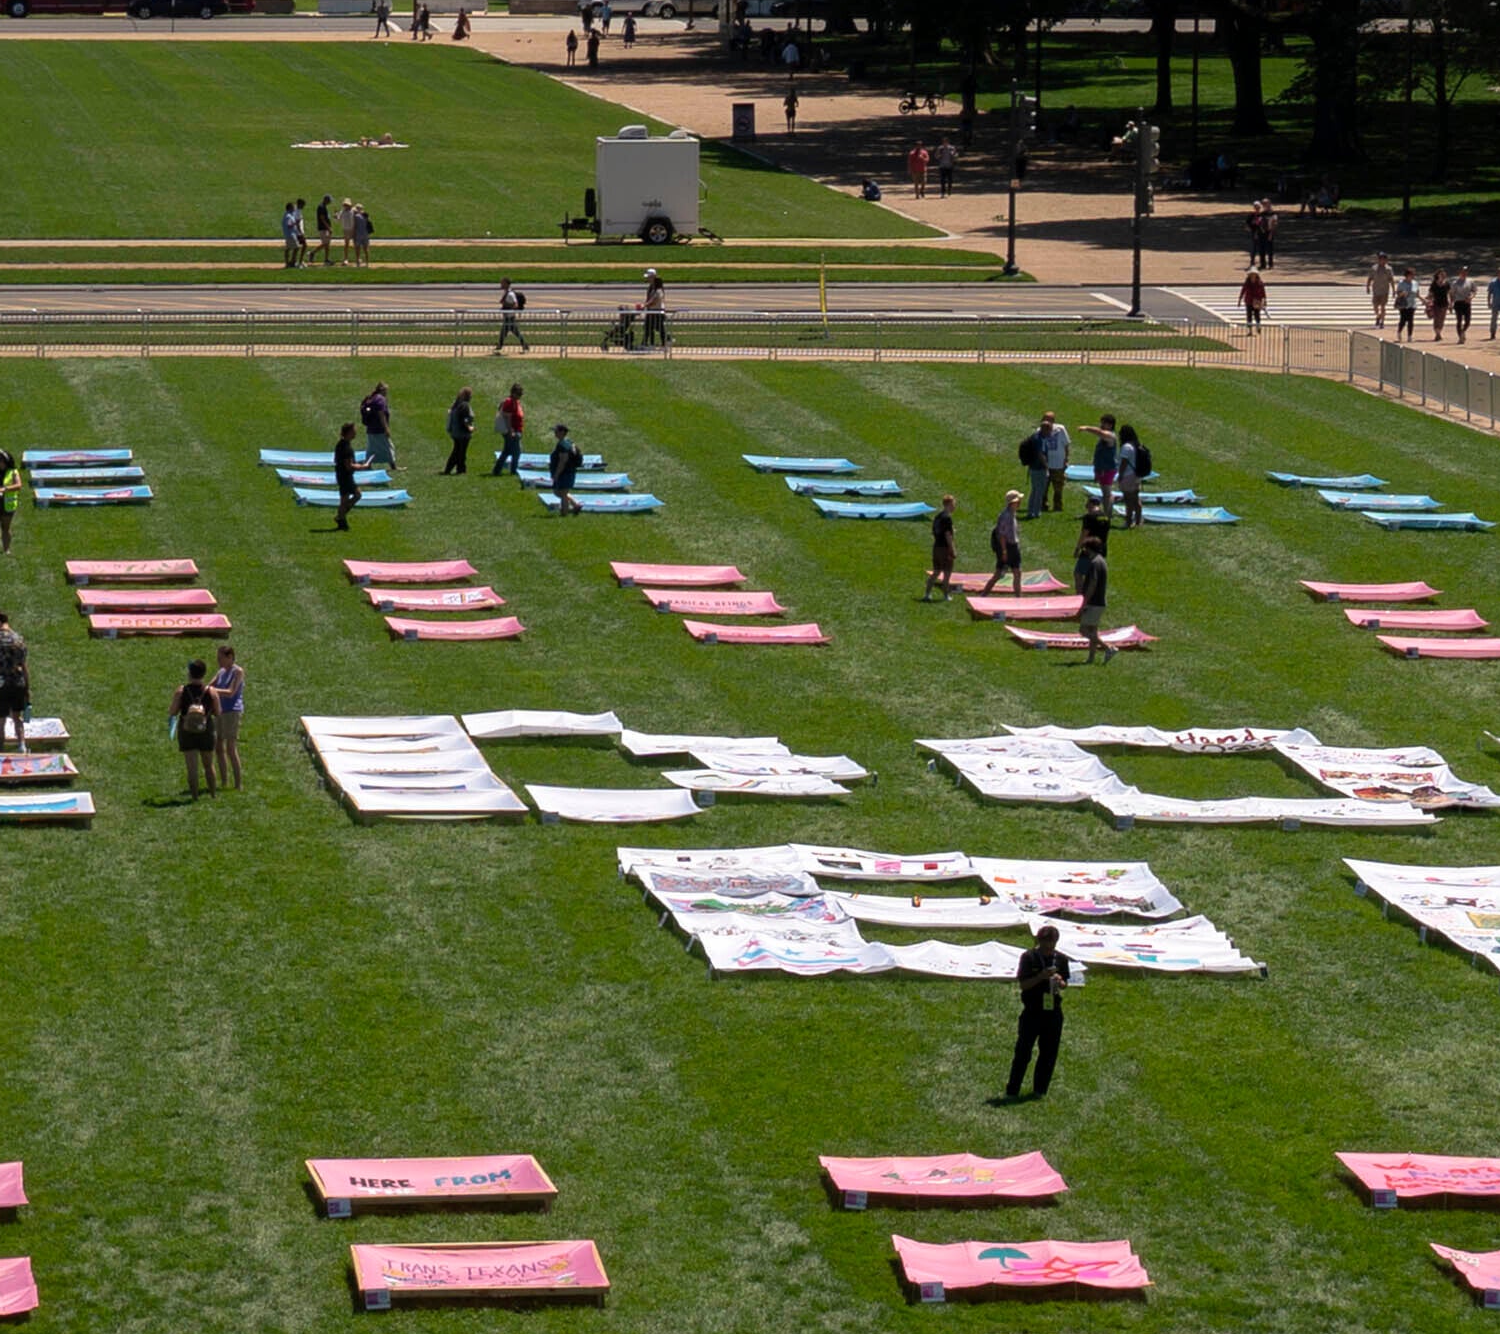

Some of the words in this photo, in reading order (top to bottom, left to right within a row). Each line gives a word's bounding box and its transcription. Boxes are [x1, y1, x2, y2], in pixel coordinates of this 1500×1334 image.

[107, 617, 203, 628] FREEDOM
[350, 1177, 415, 1188] HERE
[434, 1169, 512, 1187] FROM
[384, 1258, 450, 1275] TRANS
